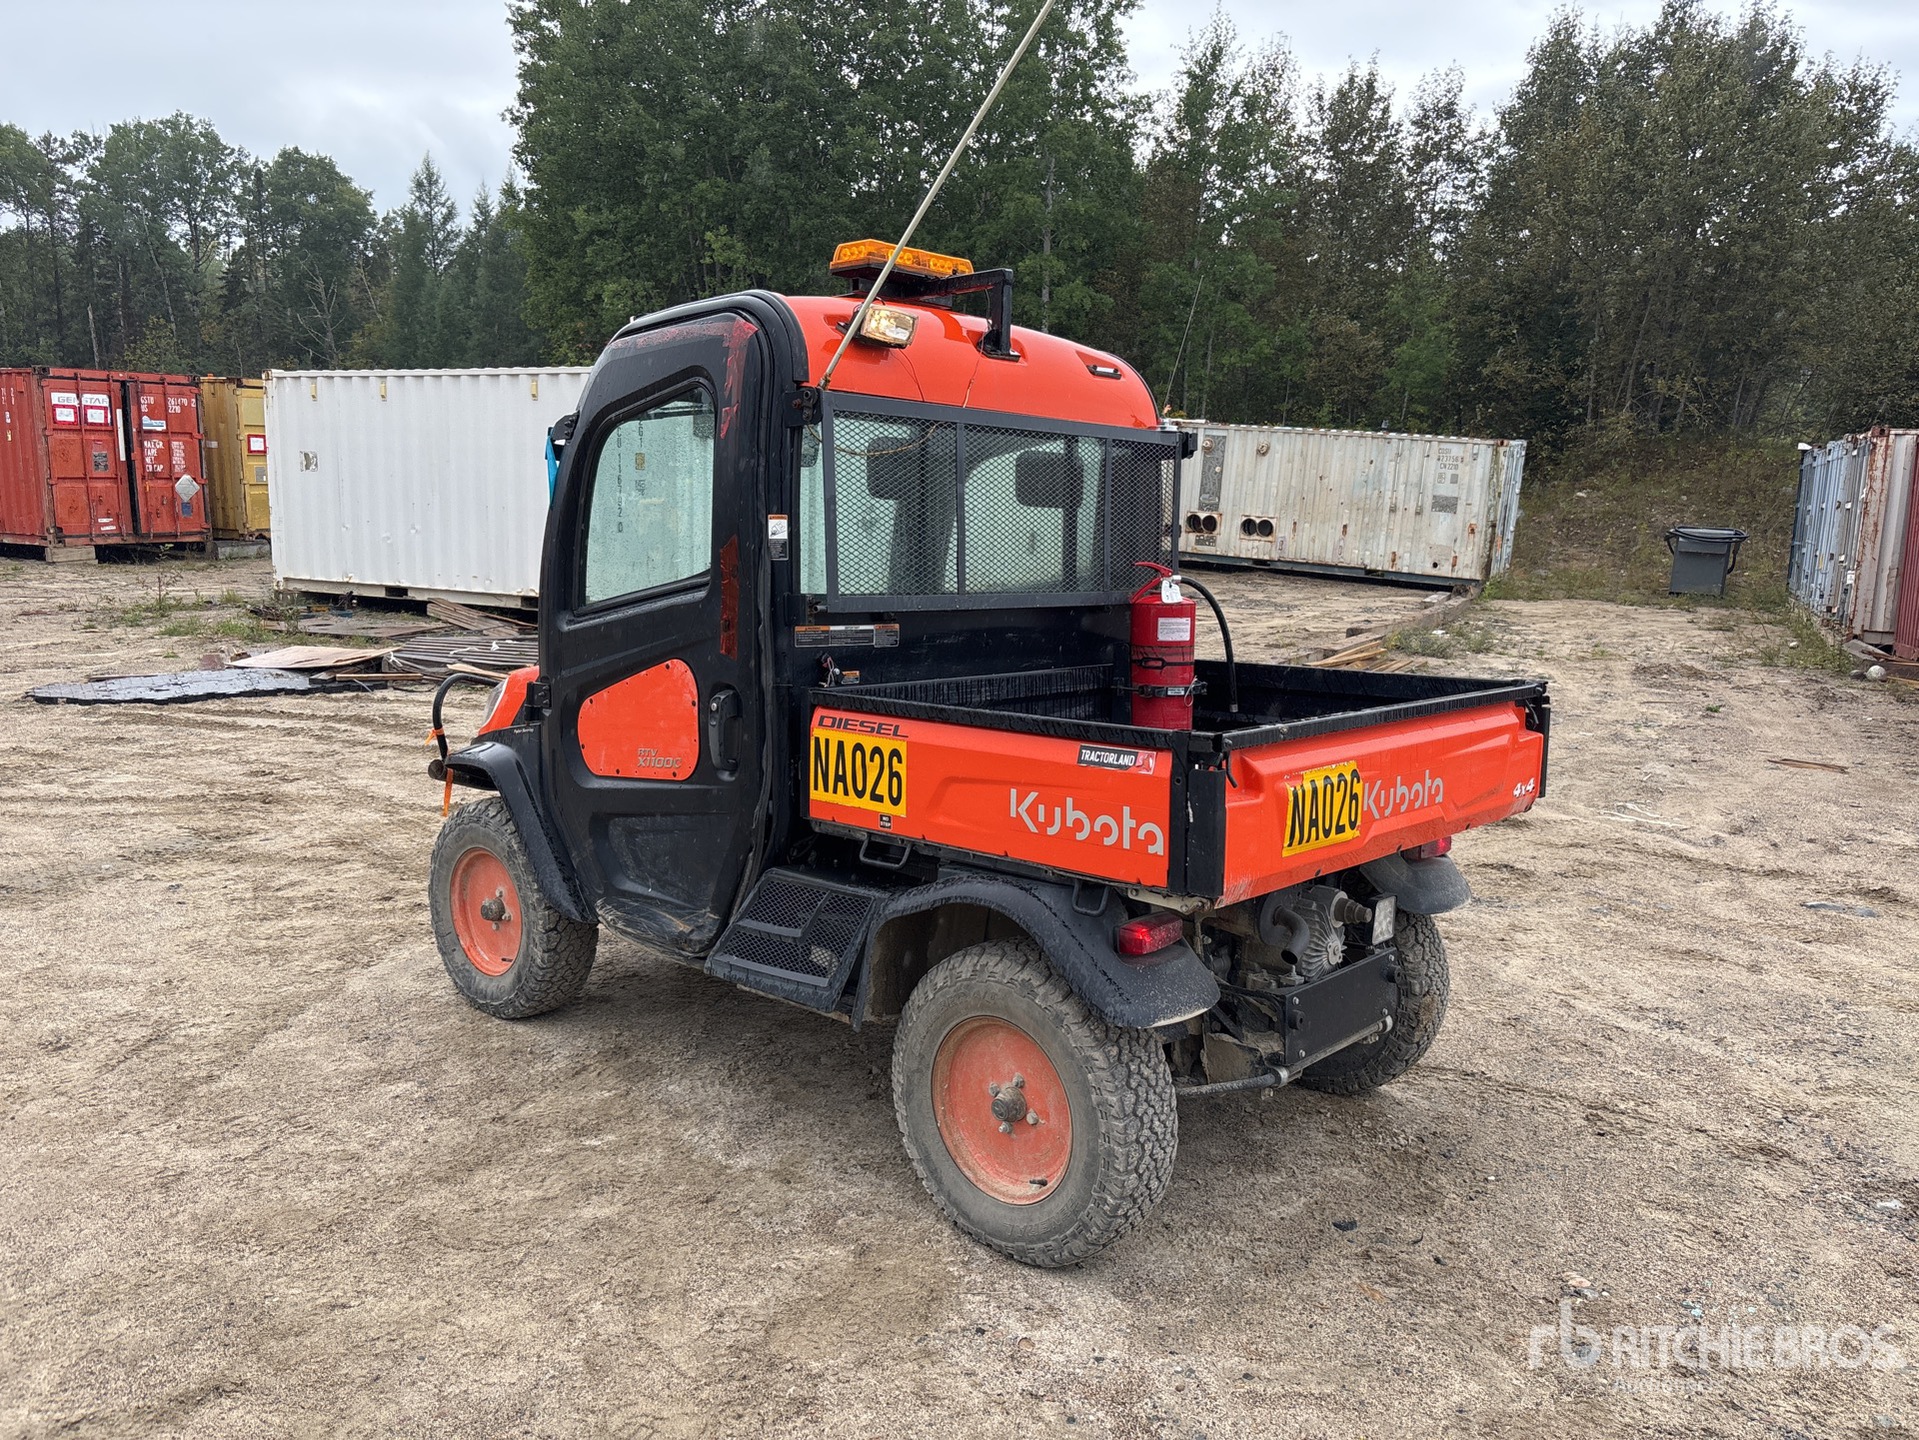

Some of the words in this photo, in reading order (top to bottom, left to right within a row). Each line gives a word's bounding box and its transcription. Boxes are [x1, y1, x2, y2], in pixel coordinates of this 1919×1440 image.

[817, 714, 909, 739] DIESEL
[637, 757, 682, 768] X1100C
[638, 748, 658, 757] RTV
[1080, 747, 1136, 767] TRACTORLAND
[813, 736, 904, 807] NA026
[1363, 769, 1443, 819] Kubota
[1512, 777, 1536, 798] 4x4
[1287, 767, 1361, 847] NA026
[1009, 788, 1164, 856] Kubota
